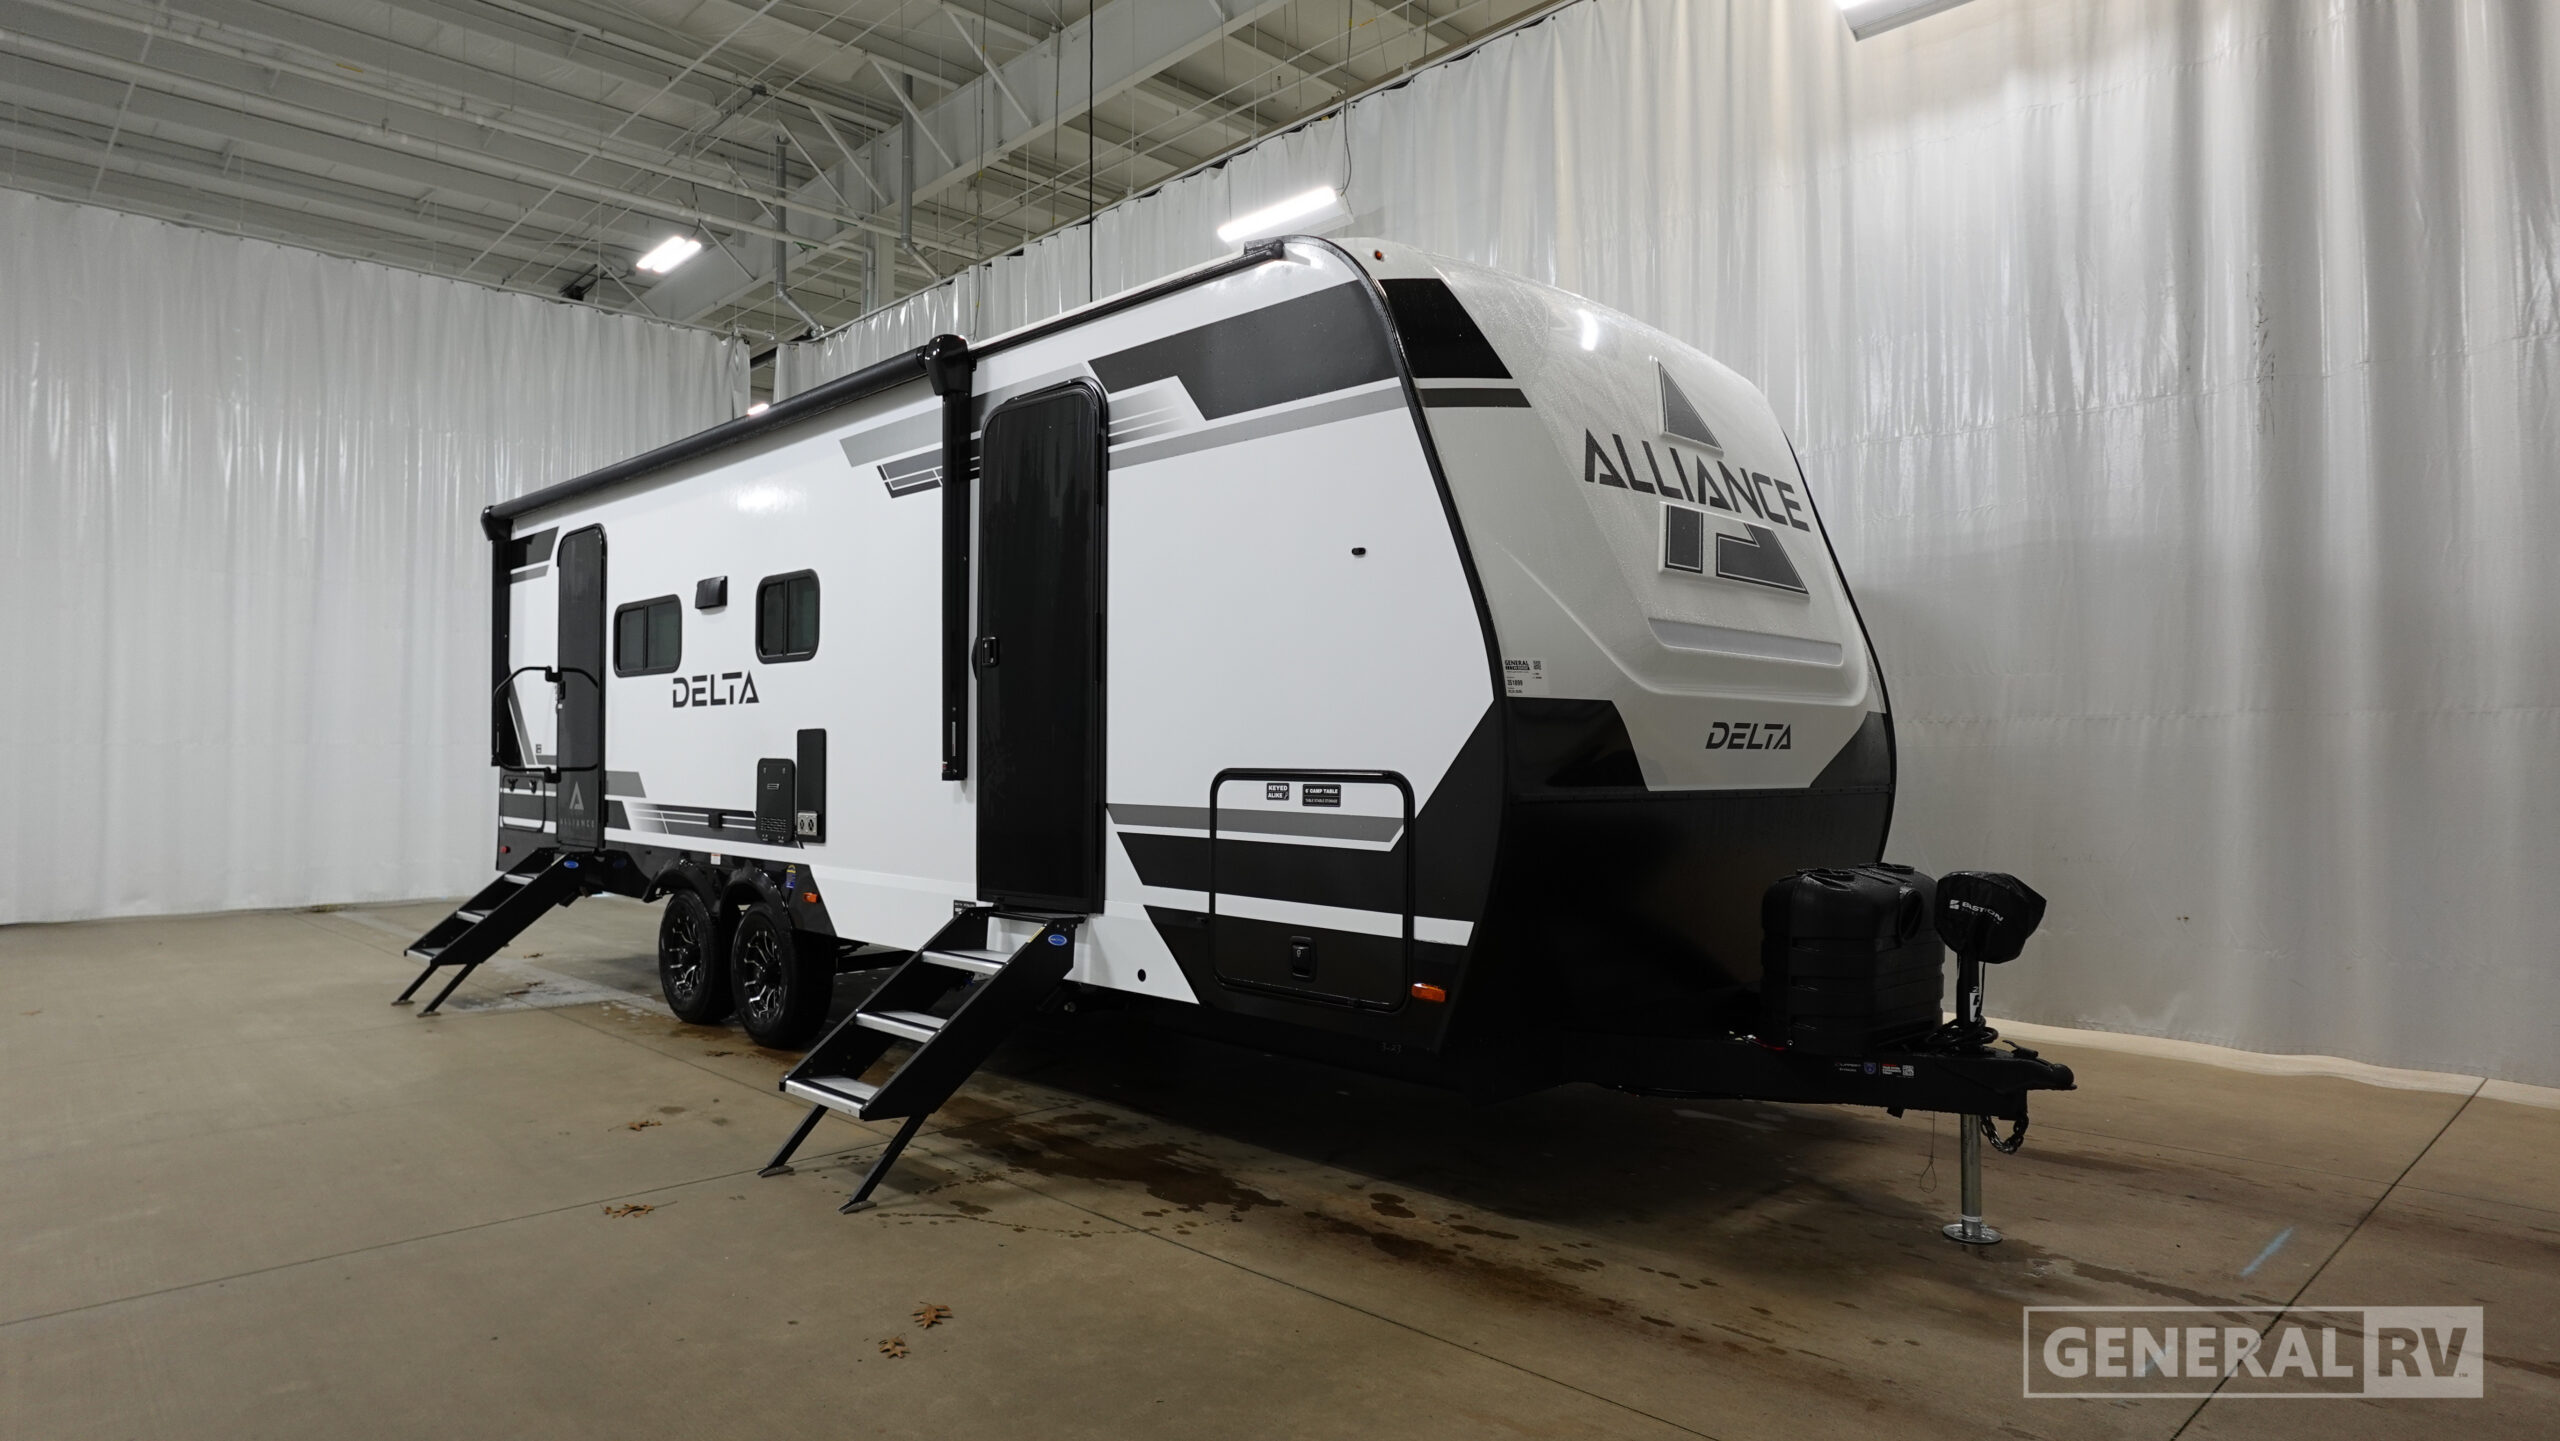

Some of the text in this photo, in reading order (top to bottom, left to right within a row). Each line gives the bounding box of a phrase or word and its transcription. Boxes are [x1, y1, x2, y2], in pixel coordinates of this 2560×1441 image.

[1584, 427, 1811, 532] ALLIANCE
[673, 670, 760, 708] DELTA
[1705, 721, 1792, 750] DELTA
